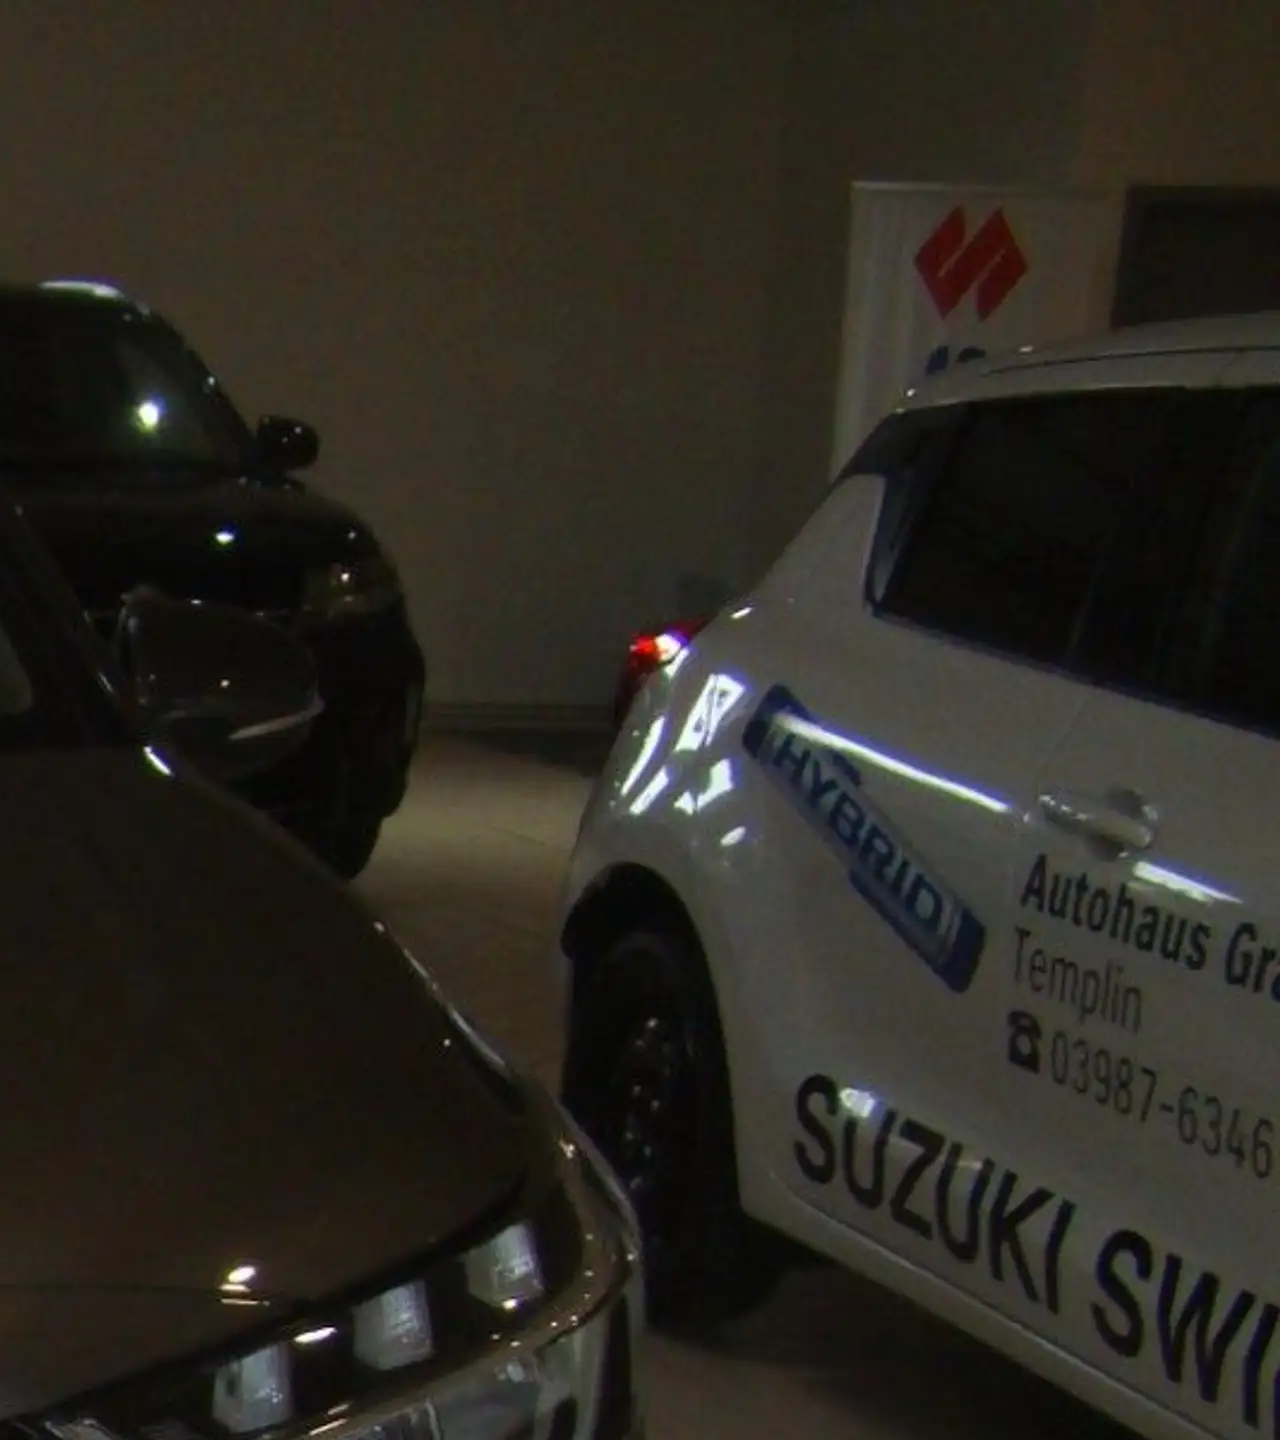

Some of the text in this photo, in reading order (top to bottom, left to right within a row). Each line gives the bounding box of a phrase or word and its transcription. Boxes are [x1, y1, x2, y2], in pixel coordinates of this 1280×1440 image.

[772, 730, 943, 929] HYBRID
[1013, 926, 1143, 1034] Templin
[1020, 853, 1211, 970] Autohaus
[1051, 1031, 1273, 1179] 03987-6346
[794, 1074, 1076, 1316] SUZUKI
